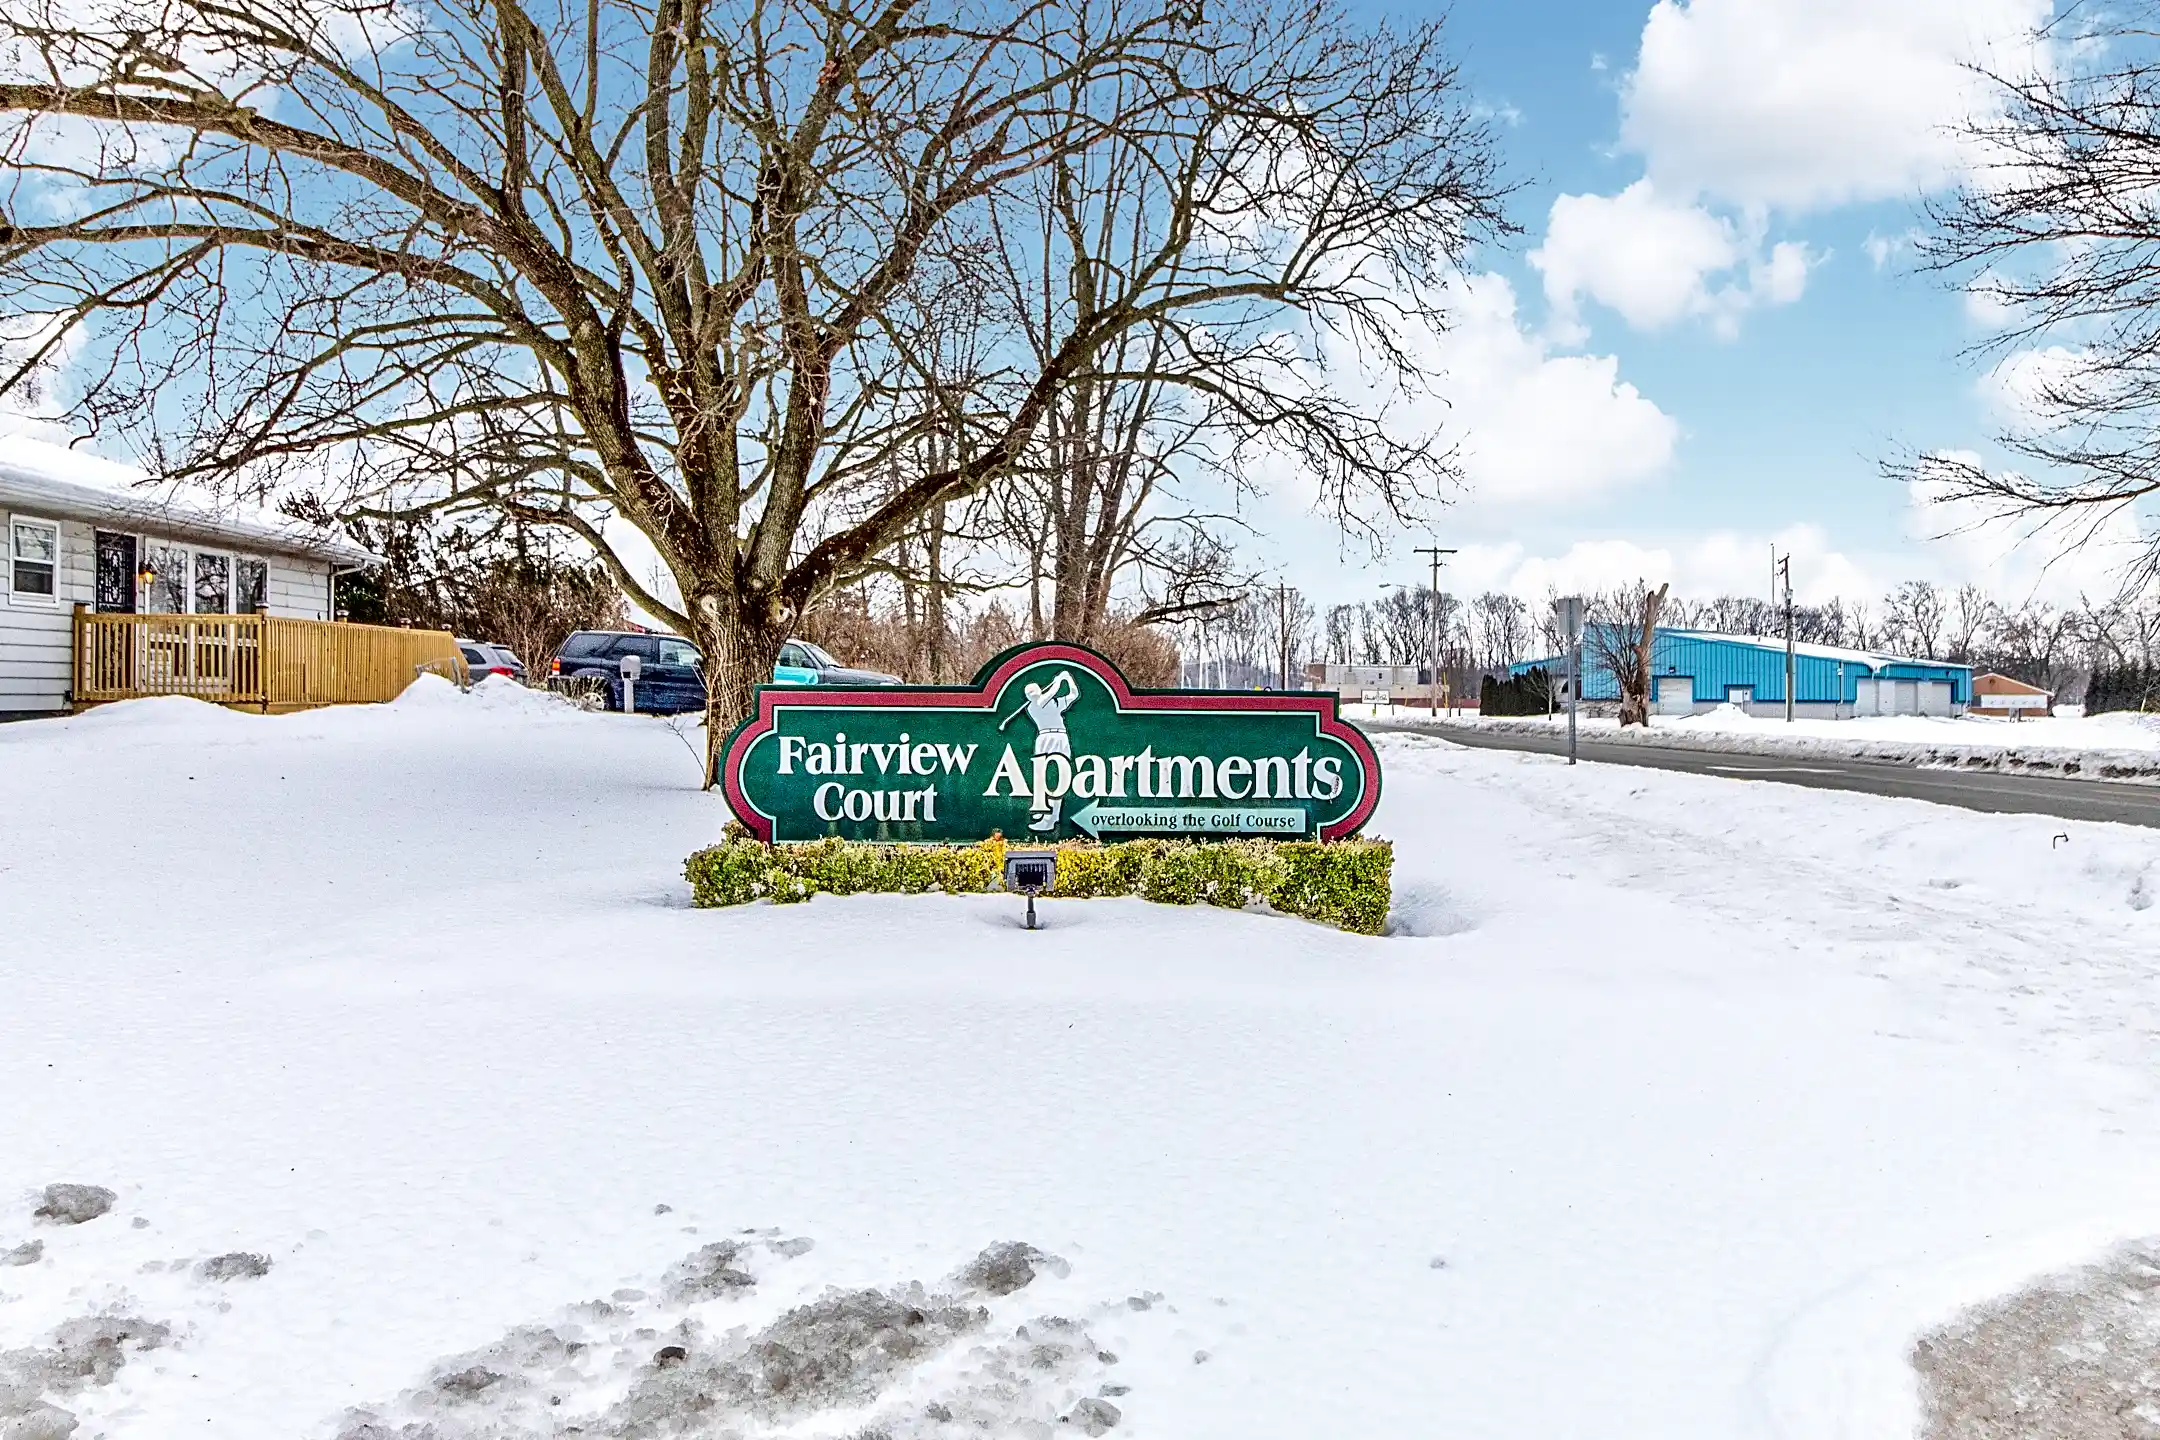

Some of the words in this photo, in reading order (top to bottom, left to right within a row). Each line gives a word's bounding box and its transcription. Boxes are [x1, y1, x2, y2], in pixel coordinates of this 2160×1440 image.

[776, 732, 979, 775] Fairview
[982, 743, 1344, 812] Apartments
[813, 781, 938, 822] Court
[1091, 813, 1177, 829] overlooking
[1182, 813, 1206, 827] the
[1211, 813, 1242, 827] Golf
[1246, 814, 1296, 828] Course
